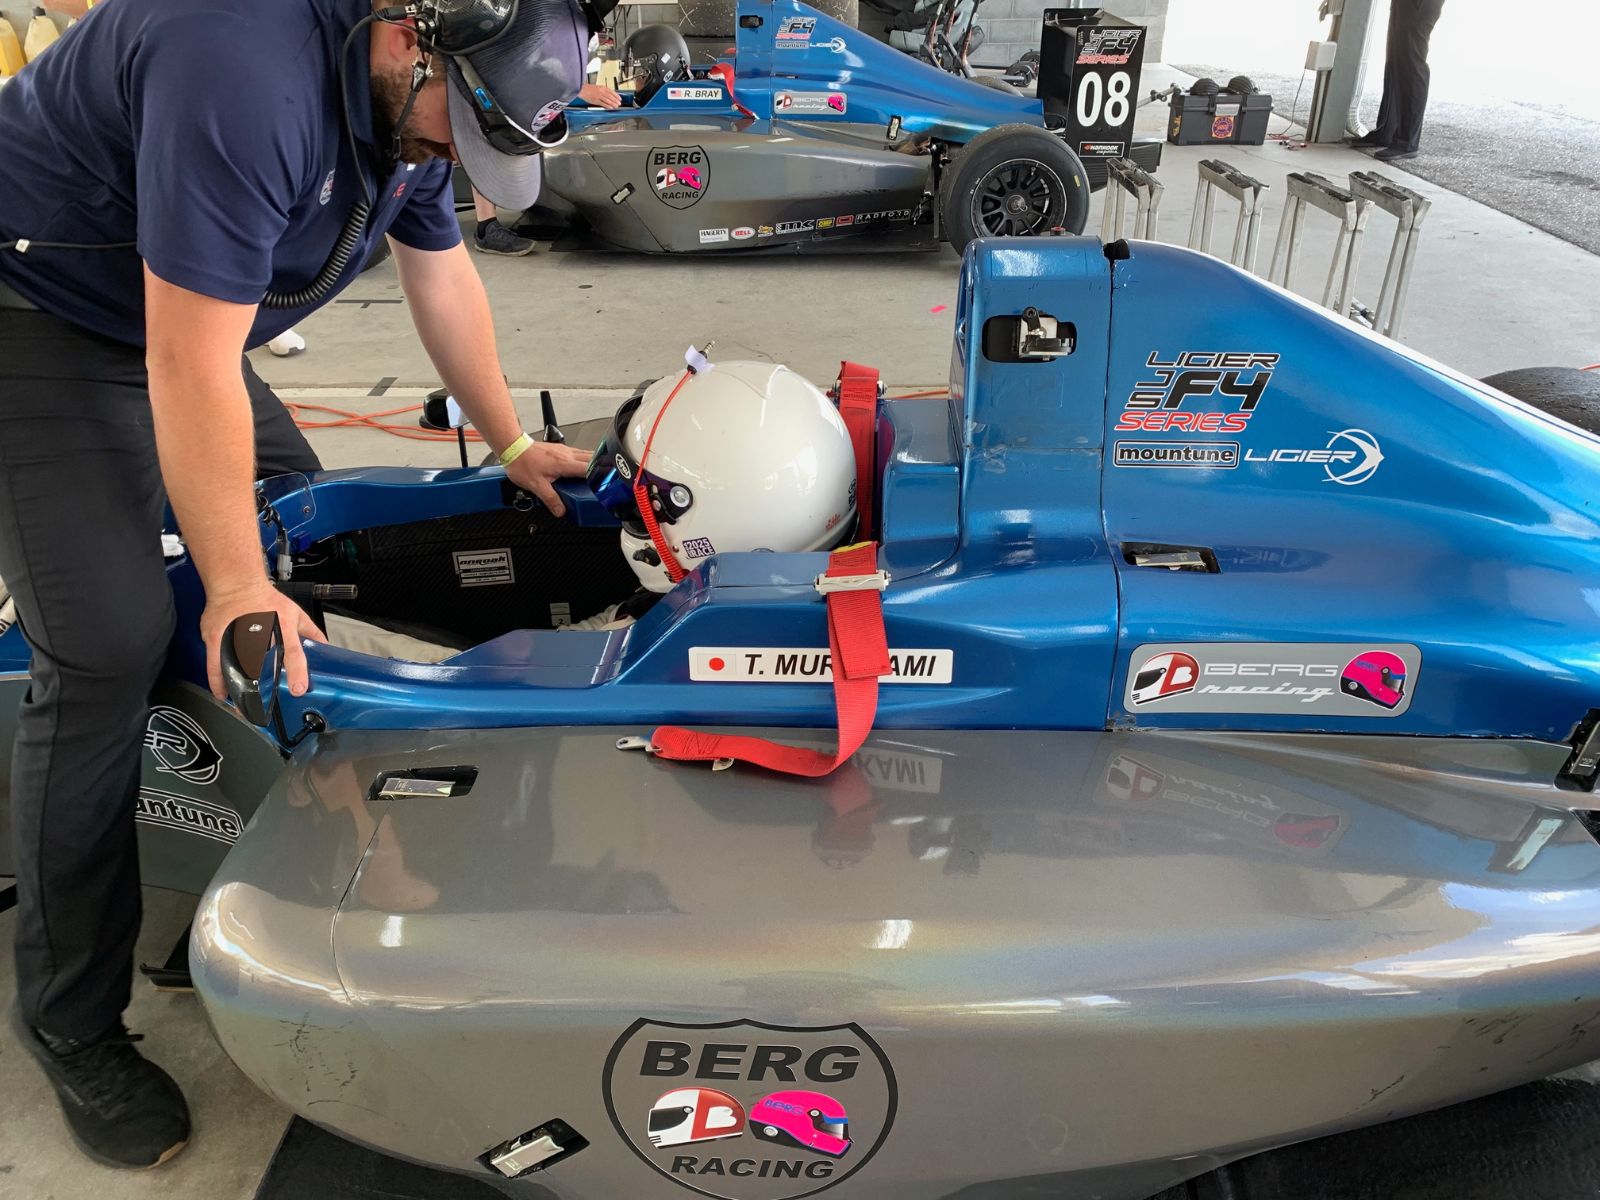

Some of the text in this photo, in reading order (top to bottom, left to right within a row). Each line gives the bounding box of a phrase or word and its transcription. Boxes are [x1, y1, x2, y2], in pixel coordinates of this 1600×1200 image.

[788, 22, 815, 33] F4
[1097, 37, 1139, 55] F4
[684, 90, 719, 98] R. BRAY
[1076, 71, 1131, 127] 08
[653, 151, 702, 166] BERG
[661, 190, 699, 200] RACING
[856, 210, 911, 220] RADFORD
[700, 229, 727, 237] HAGERTY
[735, 229, 752, 237] BELL
[1146, 351, 1281, 370] LIGIER
[1162, 371, 1273, 411] F4
[1114, 411, 1253, 433] SERIES
[1118, 445, 1235, 464] mountune
[1243, 448, 1358, 465] LIGIER
[687, 538, 711, 550] 2025
[690, 545, 715, 557] RACE
[744, 653, 937, 677] T. MURAMI
[1203, 663, 1339, 677] BERG
[1197, 682, 1335, 703] racing
[639, 1040, 861, 1083] BERG
[671, 1155, 834, 1179] RACING
